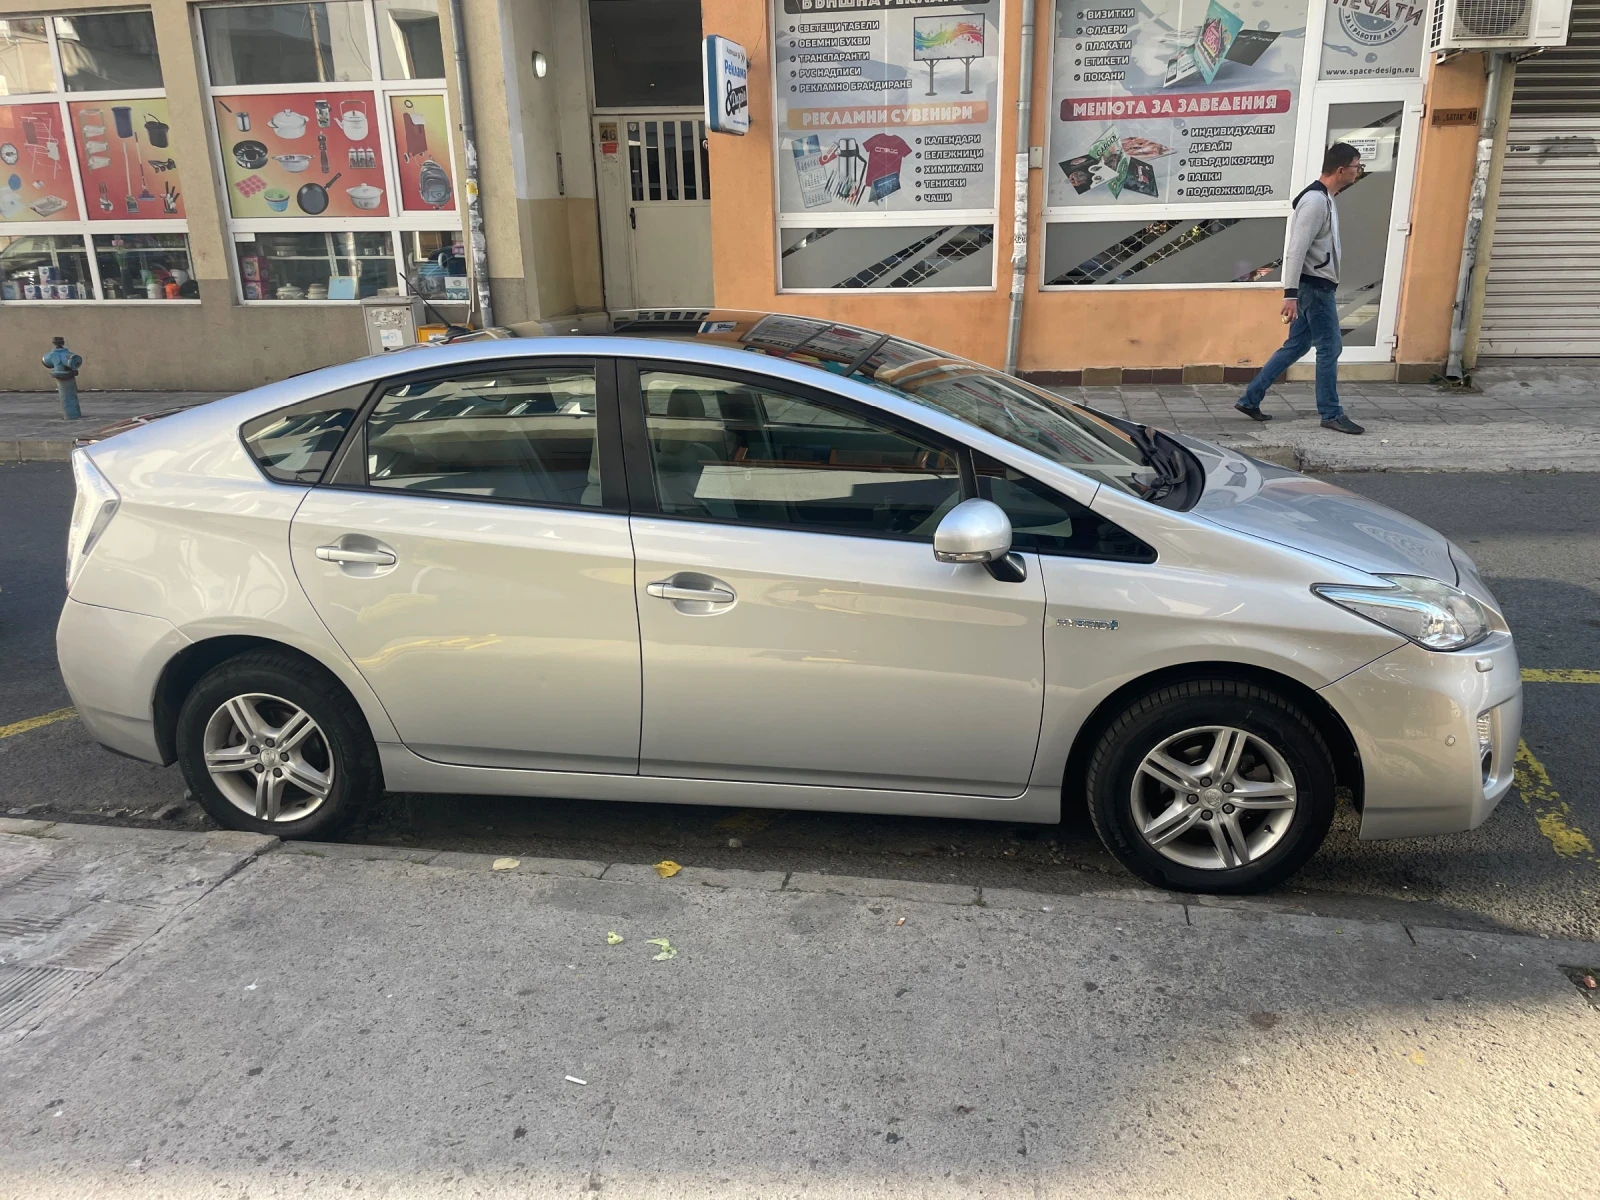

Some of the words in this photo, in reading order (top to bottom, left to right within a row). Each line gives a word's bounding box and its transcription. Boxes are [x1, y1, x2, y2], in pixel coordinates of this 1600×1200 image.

[1087, 8, 1135, 20] ВИЗИТКИ
[798, 23, 842, 33] СВЕТЕЩИ
[842, 21, 879, 32] ТАБЕЛИ
[1086, 25, 1127, 36] ФЛАЕРИ
[1352, 28, 1382, 40] РАБОТЕН
[798, 38, 838, 48] ОБЕМНИ
[838, 36, 870, 46] БУКВИ
[1085, 40, 1132, 50] ПЛАКАТИ
[799, 52, 870, 62] ТРАНСПАРАНТИ
[1084, 56, 1129, 66] ЕТИКЕТИ
[799, 68, 816, 78] PVC
[817, 67, 861, 78] НАДПИСИ
[1326, 66, 1415, 76] www.space-design.eu
[1084, 72, 1125, 82] ПОКАНИ
[800, 83, 849, 92] РЕКЛАМНО
[850, 80, 912, 92] БРАНДИРАНЕ
[1073, 100, 1146, 116] МЕНЮТА
[1152, 99, 1173, 114] ЗА
[1178, 95, 1277, 112] ЗАВЕДЕНИЯ
[802, 109, 888, 126] РЕКЛАМНИ
[891, 106, 972, 123] СУВЕНИРИ
[1468, 110, 1477, 120] 46
[602, 130, 616, 140] 46
[1191, 126, 1274, 138] ИНДИВИДУАЛЕН
[924, 134, 981, 146] КАЛЕНДАРИ
[1190, 141, 1232, 154] ДИЗАЙН
[924, 150, 984, 160] БЕЛЕЖНИЦИ
[1188, 157, 1229, 168] ТВЪРДИ
[1231, 155, 1274, 166] КОРИЦИ
[924, 164, 984, 174] ХИМИКАЛКИ
[1188, 172, 1222, 182] ПАПКИ
[924, 178, 966, 188] ТЕНИСКИ
[1186, 186, 1244, 197] ПОДЛОЖКИ
[1246, 186, 1254, 194] И
[1254, 185, 1273, 196] ДР.
[924, 194, 952, 202] ЧАШИ
